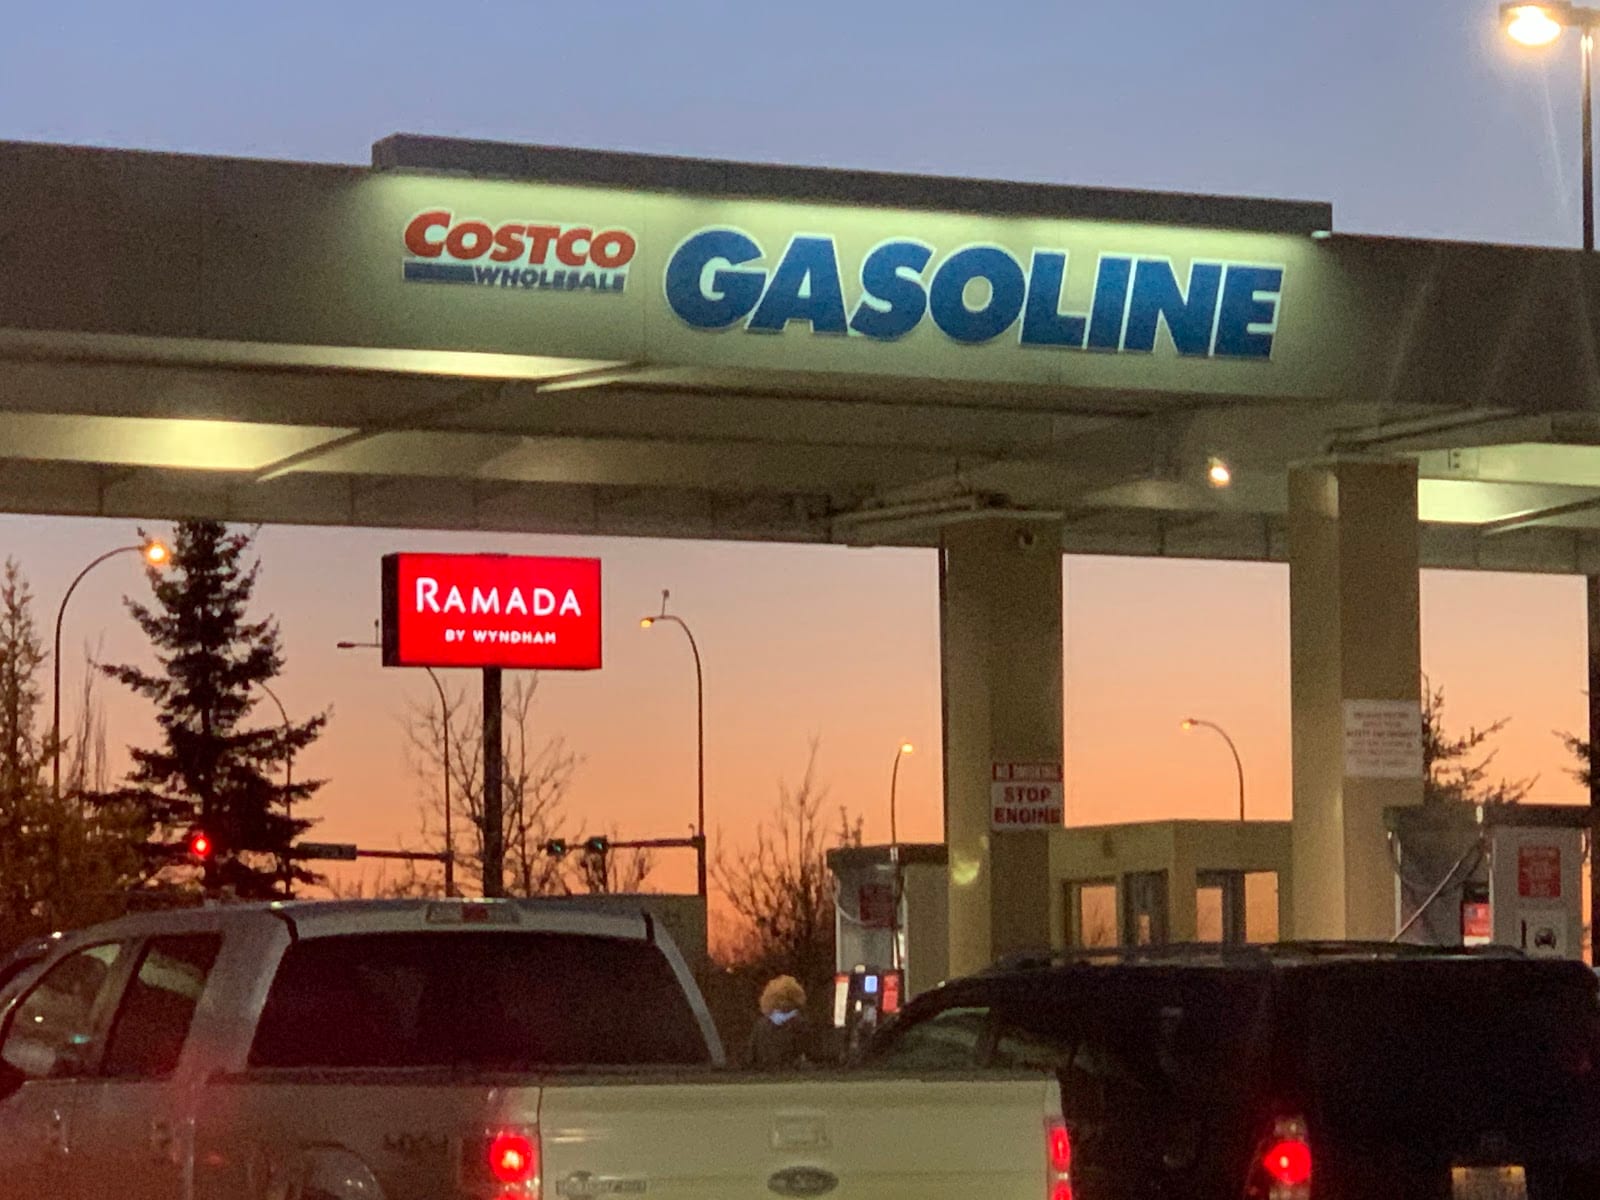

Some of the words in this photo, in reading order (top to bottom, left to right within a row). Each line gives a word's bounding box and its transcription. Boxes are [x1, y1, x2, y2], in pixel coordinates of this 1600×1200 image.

[404, 211, 636, 268] COSTCO
[476, 265, 625, 291] WHOLESALE
[665, 226, 1285, 362] GASOLINE
[415, 576, 582, 617] RAMADA
[445, 628, 465, 643] BY
[473, 629, 556, 645] WYNDHAM
[1003, 785, 1051, 803] STOP
